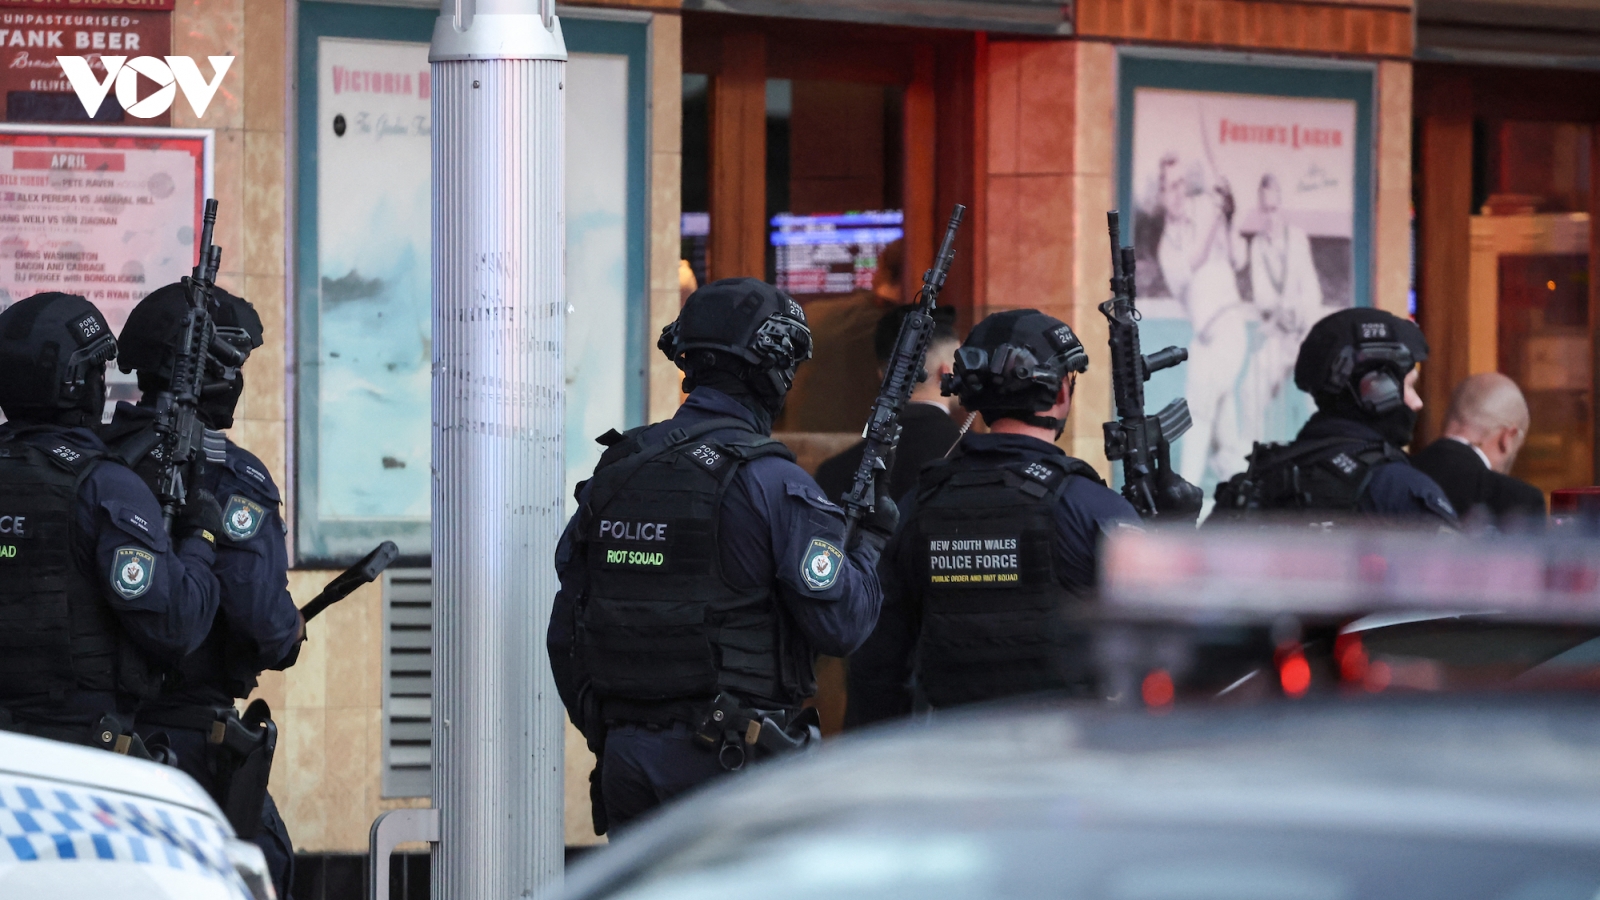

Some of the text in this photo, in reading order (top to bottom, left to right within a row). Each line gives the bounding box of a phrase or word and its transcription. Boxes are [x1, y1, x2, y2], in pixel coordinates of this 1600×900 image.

[0, 29, 141, 50] TANK BEER
[332, 65, 413, 95] VICTORIA
[51, 154, 87, 169] APRIL
[62, 178, 82, 188] PETE
[17, 193, 39, 203] ALEX
[41, 194, 77, 203] PEREIRA
[79, 195, 91, 204] VS
[48, 215, 59, 224] VS
[14, 251, 41, 260] CHRIS
[43, 252, 99, 261] WASHINGTON
[15, 262, 105, 272] BACON AND CABBAGE
[94, 290, 105, 299] VS
[107, 290, 130, 300] RYAN
[83, 321, 101, 338] 265
[692, 448, 715, 466] 270
[700, 444, 720, 460] PORS
[1024, 467, 1047, 480] 244
[599, 520, 668, 541] POLICE
[930, 538, 1017, 551] NEW SOUTH WALES
[606, 549, 664, 566] RIOT SQUAD
[930, 554, 1018, 570] POLICE FORCE
[931, 575, 950, 583] PUBLIC
[970, 574, 982, 582] AND
[983, 574, 996, 582] RIOT
[997, 573, 1018, 582] SQUAD
